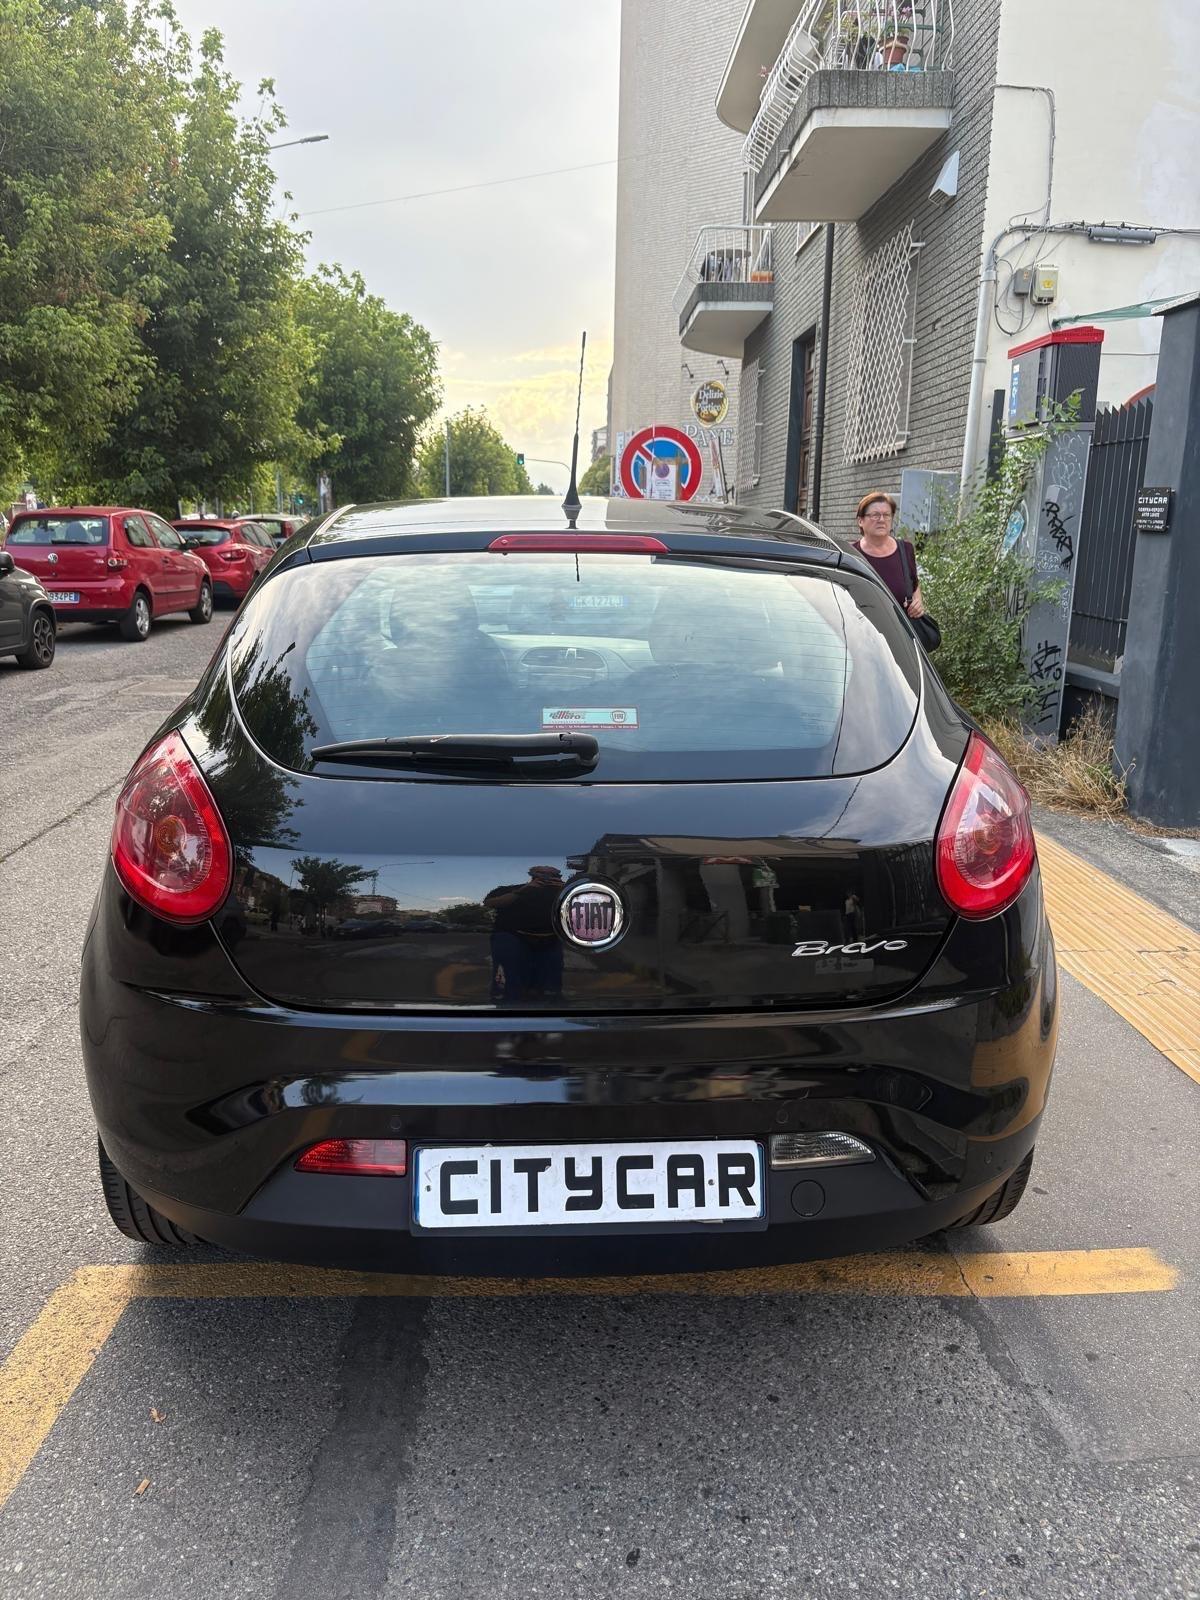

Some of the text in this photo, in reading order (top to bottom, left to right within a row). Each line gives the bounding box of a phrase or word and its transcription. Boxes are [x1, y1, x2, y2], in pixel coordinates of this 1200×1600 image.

[699, 389, 724, 399] Delizie
[696, 402, 721, 412] Portico
[683, 424, 734, 447] PANE
[1138, 496, 1168, 504] CITYCAR
[572, 901, 612, 931] FIAT
[791, 940, 908, 957] Bravo
[439, 1152, 756, 1216] CITYCAR
